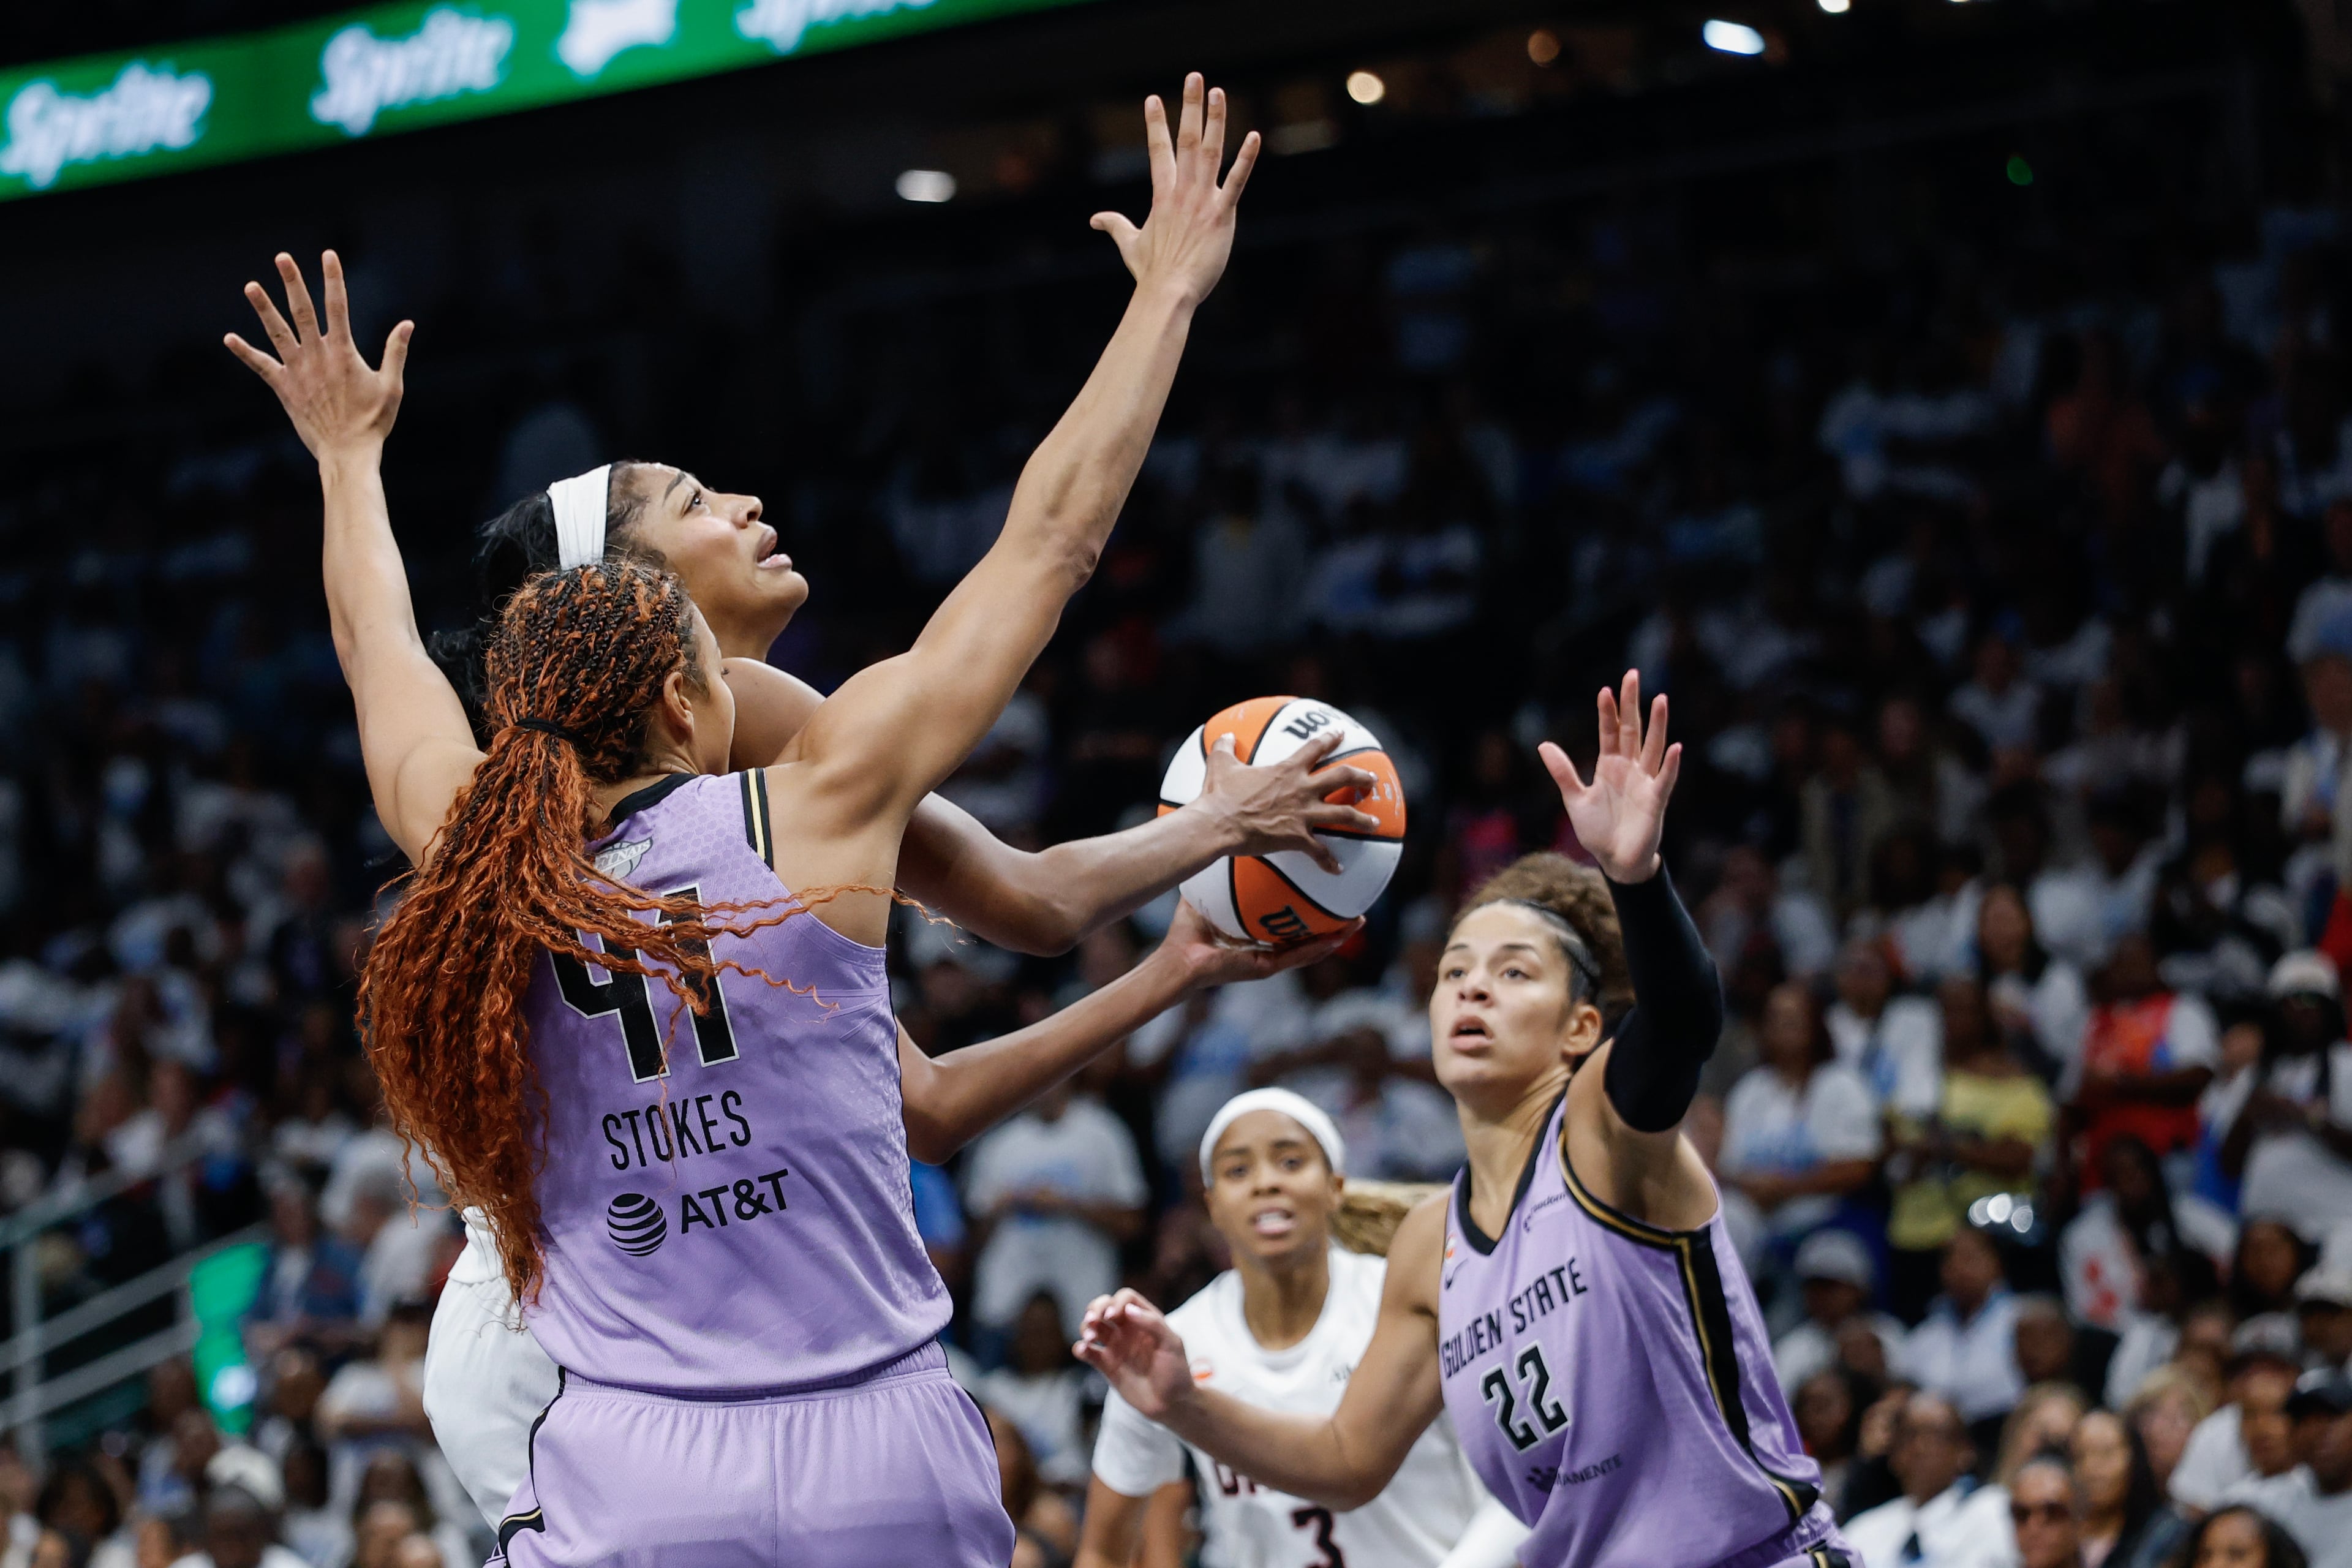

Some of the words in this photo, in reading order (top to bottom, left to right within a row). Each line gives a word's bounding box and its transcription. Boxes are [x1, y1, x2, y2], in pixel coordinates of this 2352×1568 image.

[0, 60, 214, 189] Sprite
[308, 7, 514, 136] Sprite
[547, 882, 740, 1085] 41
[601, 1090, 752, 1172] STOKES
[680, 1168, 789, 1234] AT&T
[1441, 1307, 1502, 1379] GOLDEN
[1508, 1257, 1588, 1335] STATE
[1479, 1340, 1570, 1454] 22
[1290, 1502, 1346, 1568] 3
